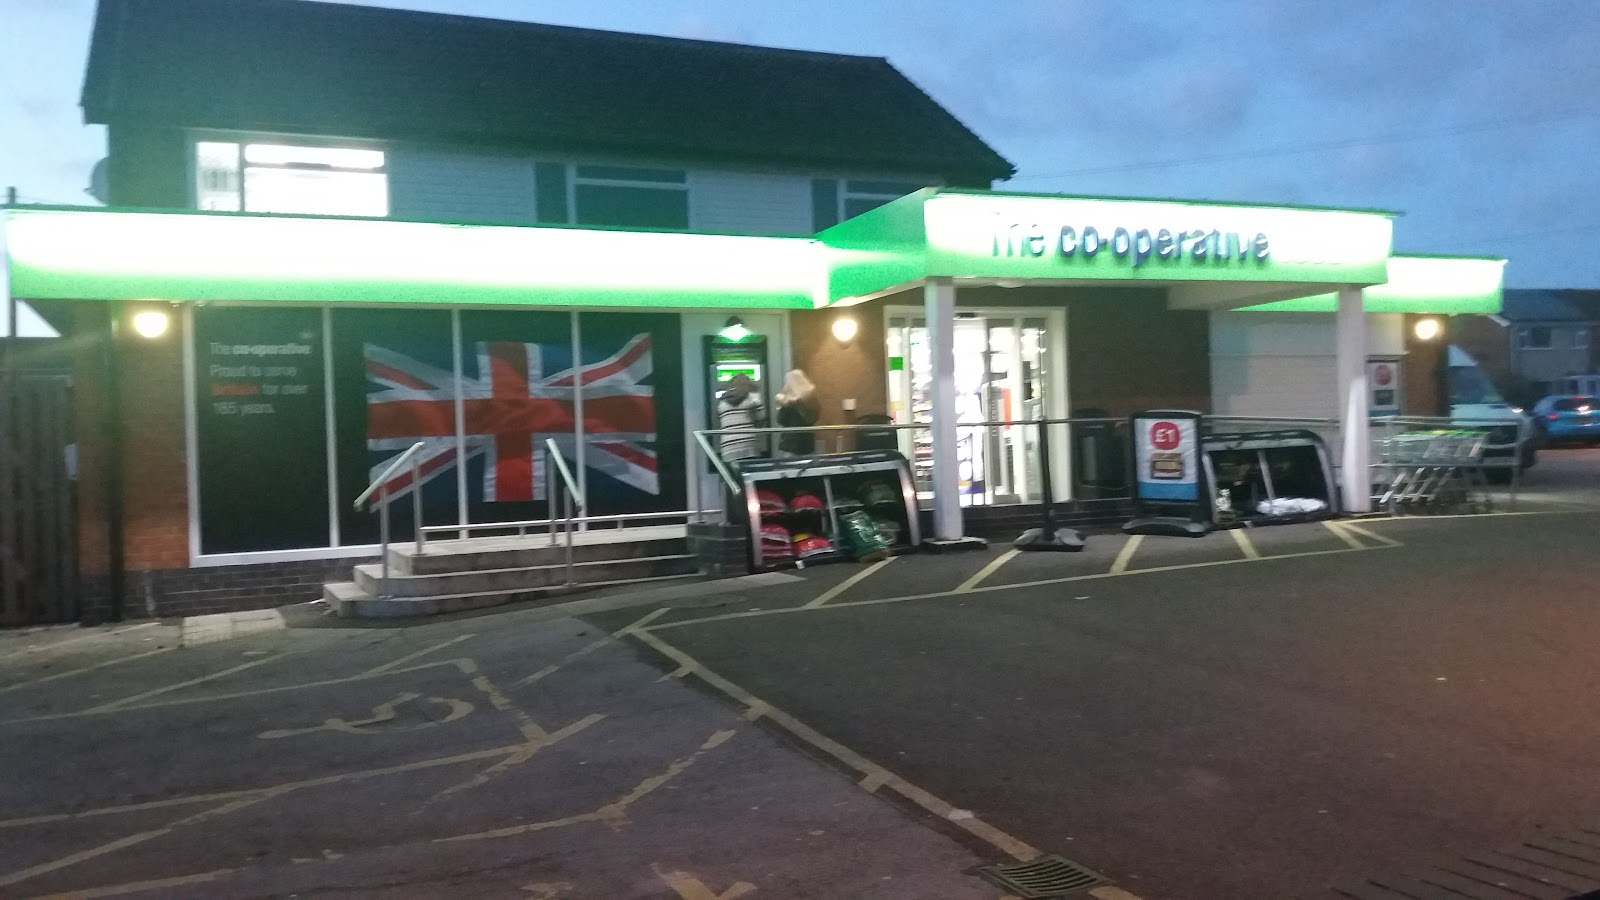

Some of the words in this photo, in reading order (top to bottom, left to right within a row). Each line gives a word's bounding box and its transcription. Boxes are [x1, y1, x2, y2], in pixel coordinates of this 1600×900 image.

[1060, 225, 1270, 268] co-operative
[209, 342, 230, 354] The
[209, 364, 246, 377] Proud
[1155, 428, 1175, 442] £1
